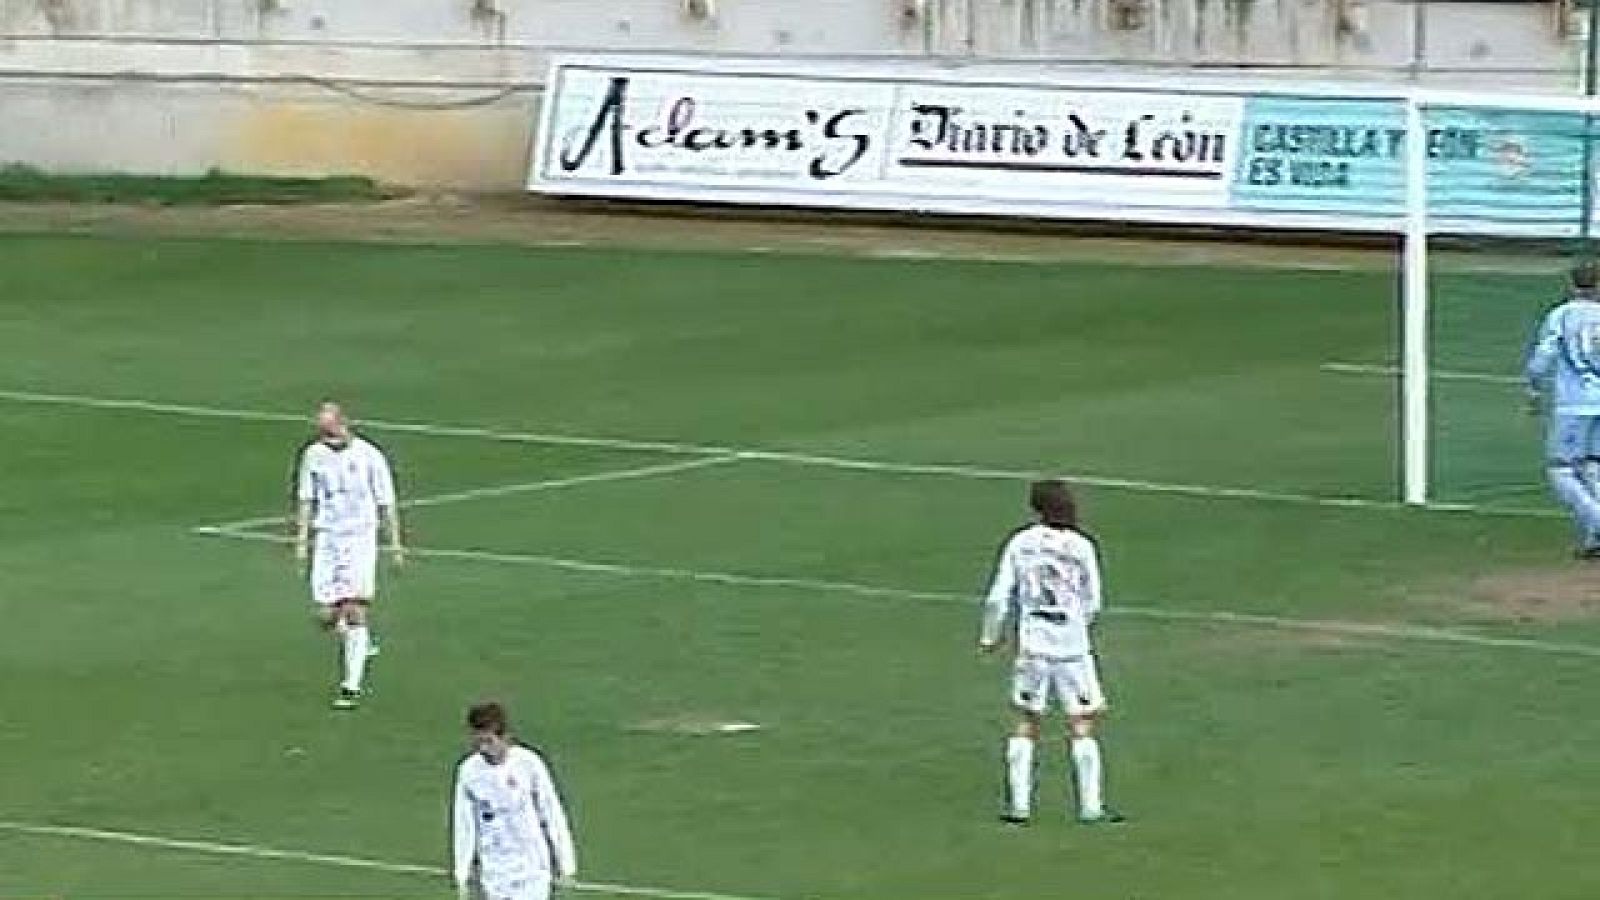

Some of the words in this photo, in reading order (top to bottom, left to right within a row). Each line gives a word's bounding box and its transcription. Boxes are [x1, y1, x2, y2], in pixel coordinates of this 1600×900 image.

[909, 102, 1047, 156] Diario
[1062, 113, 1107, 158] de
[1122, 112, 1226, 162] León
[1254, 124, 1382, 158] CASTILLA
[1250, 157, 1283, 185] ES
